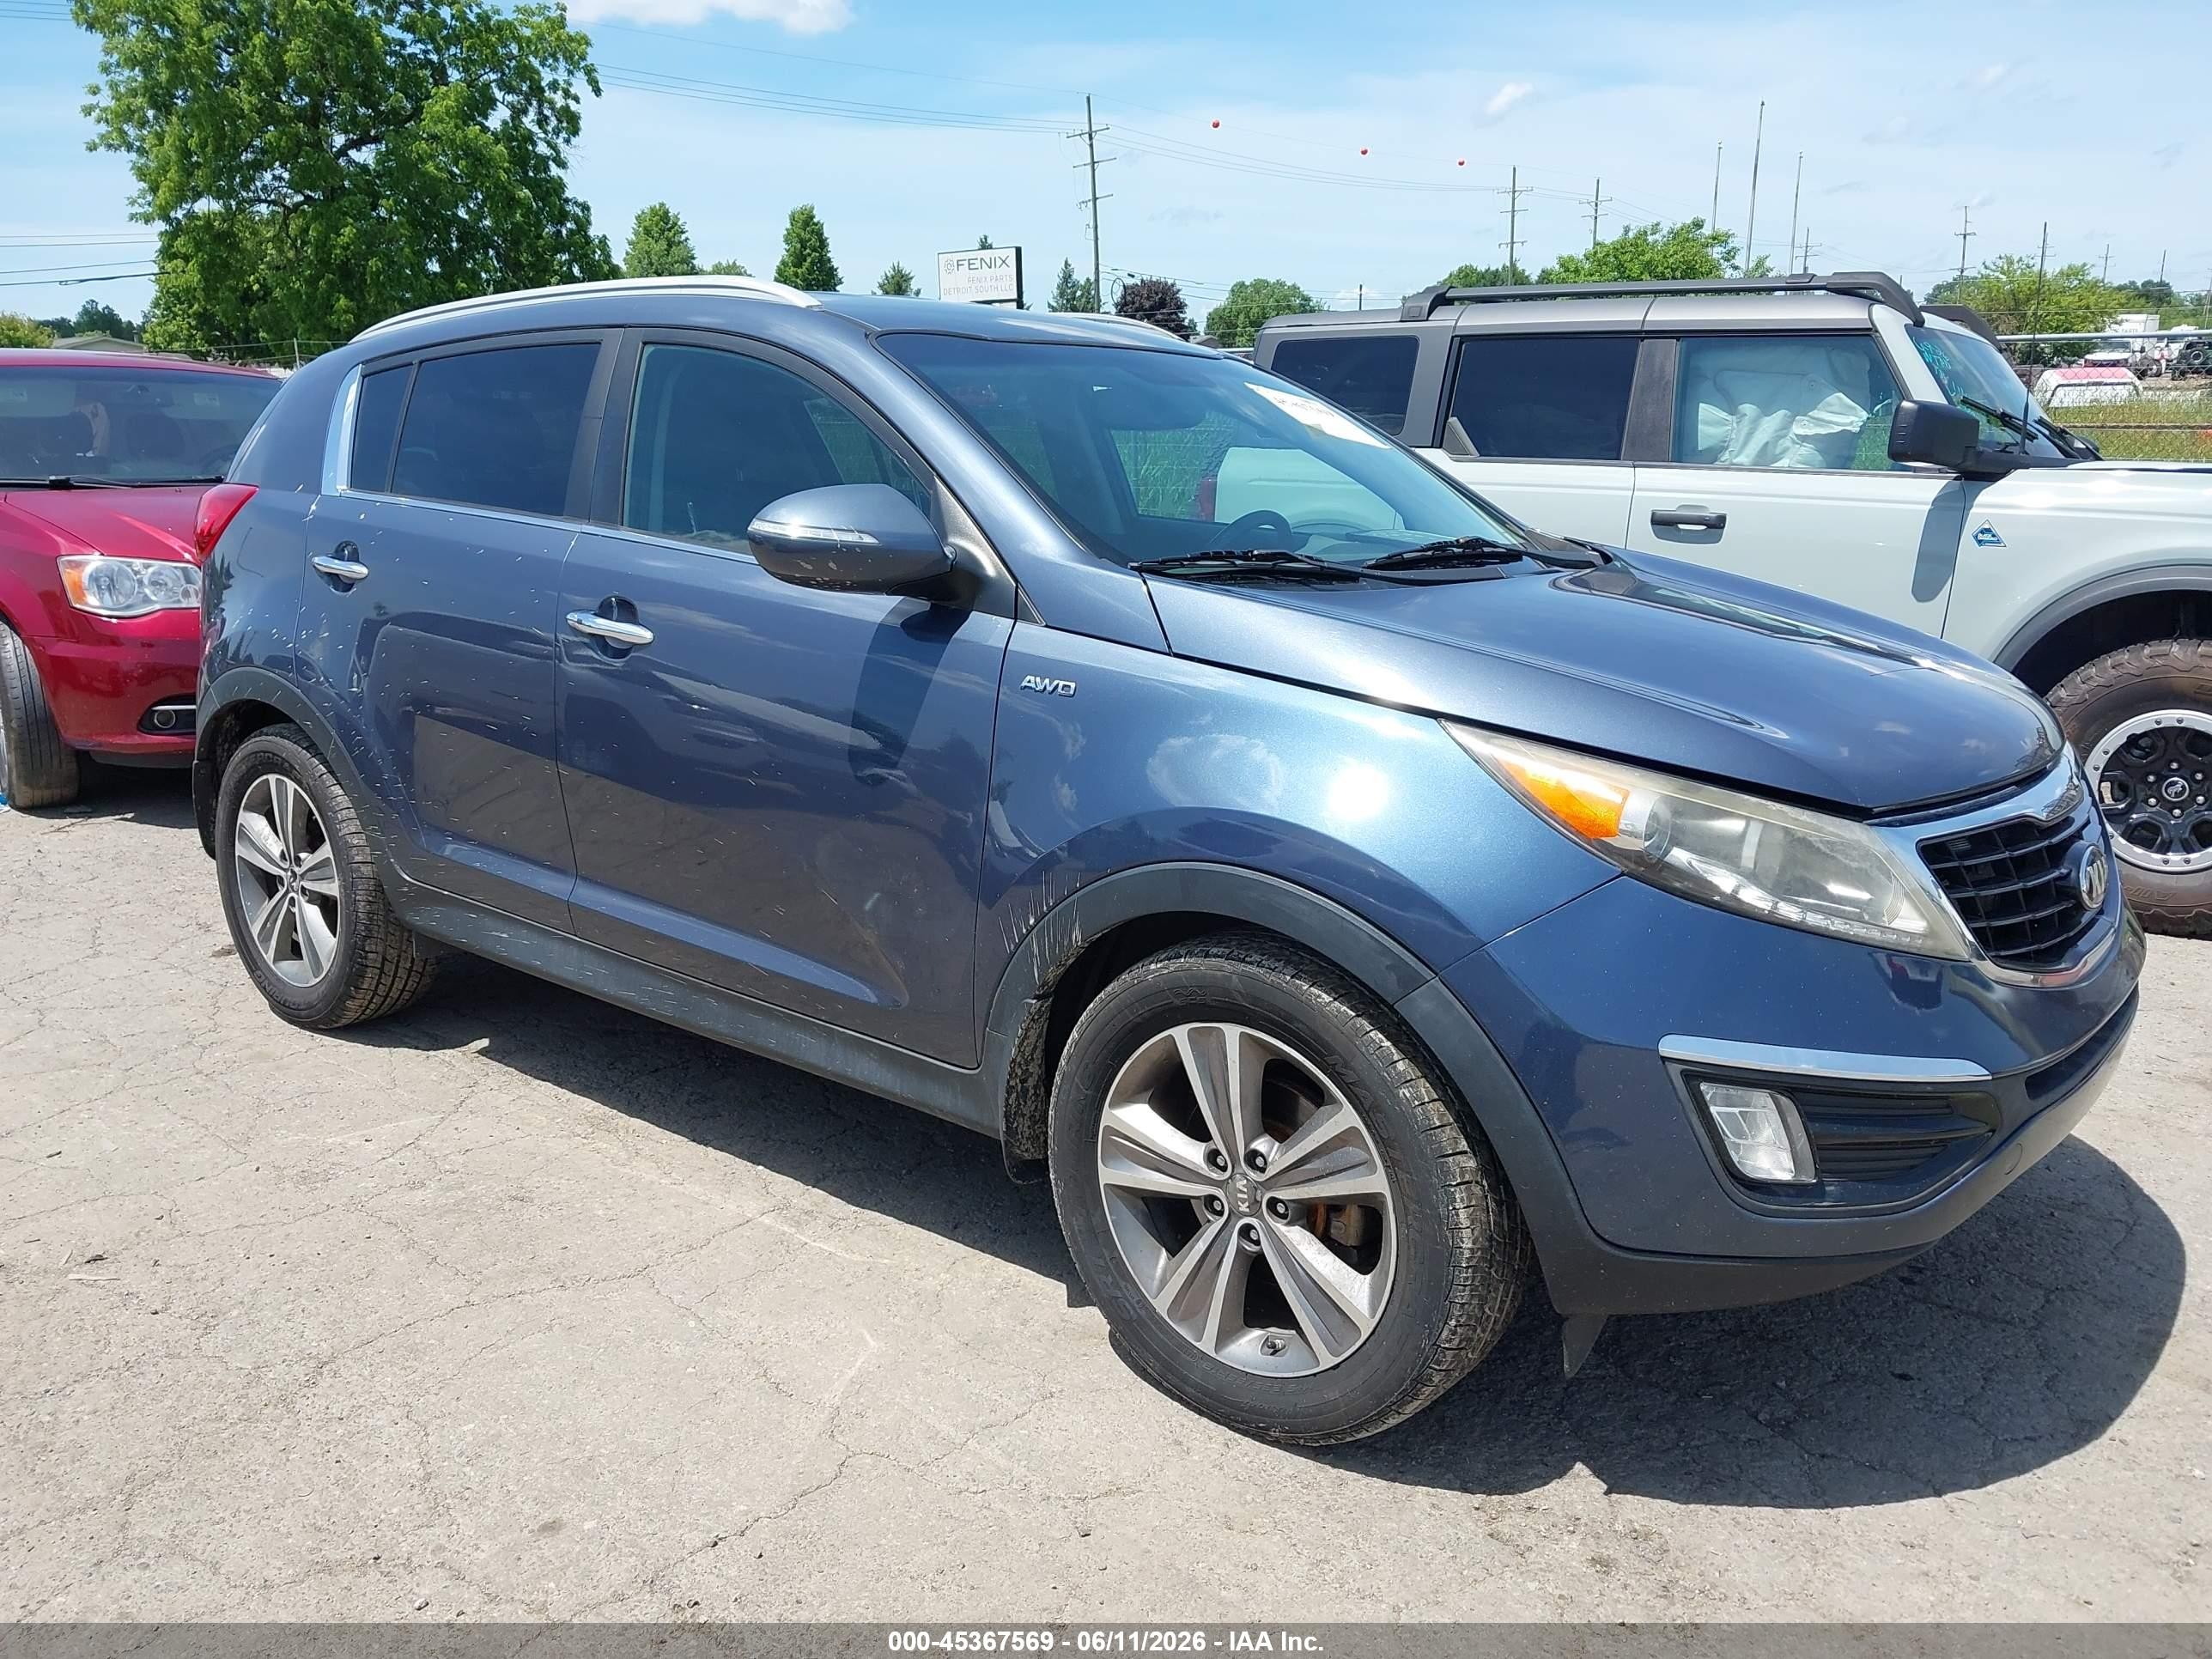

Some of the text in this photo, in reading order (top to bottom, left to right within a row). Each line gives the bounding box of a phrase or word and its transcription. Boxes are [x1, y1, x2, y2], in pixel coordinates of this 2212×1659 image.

[956, 255, 1011, 272] FENIX
[968, 274, 1013, 284] FENIX PARTS
[944, 283, 1013, 296] DETROIT SOUTH LLC
[1019, 674, 1076, 697] AWD
[1237, 1178, 1250, 1212] KIA
